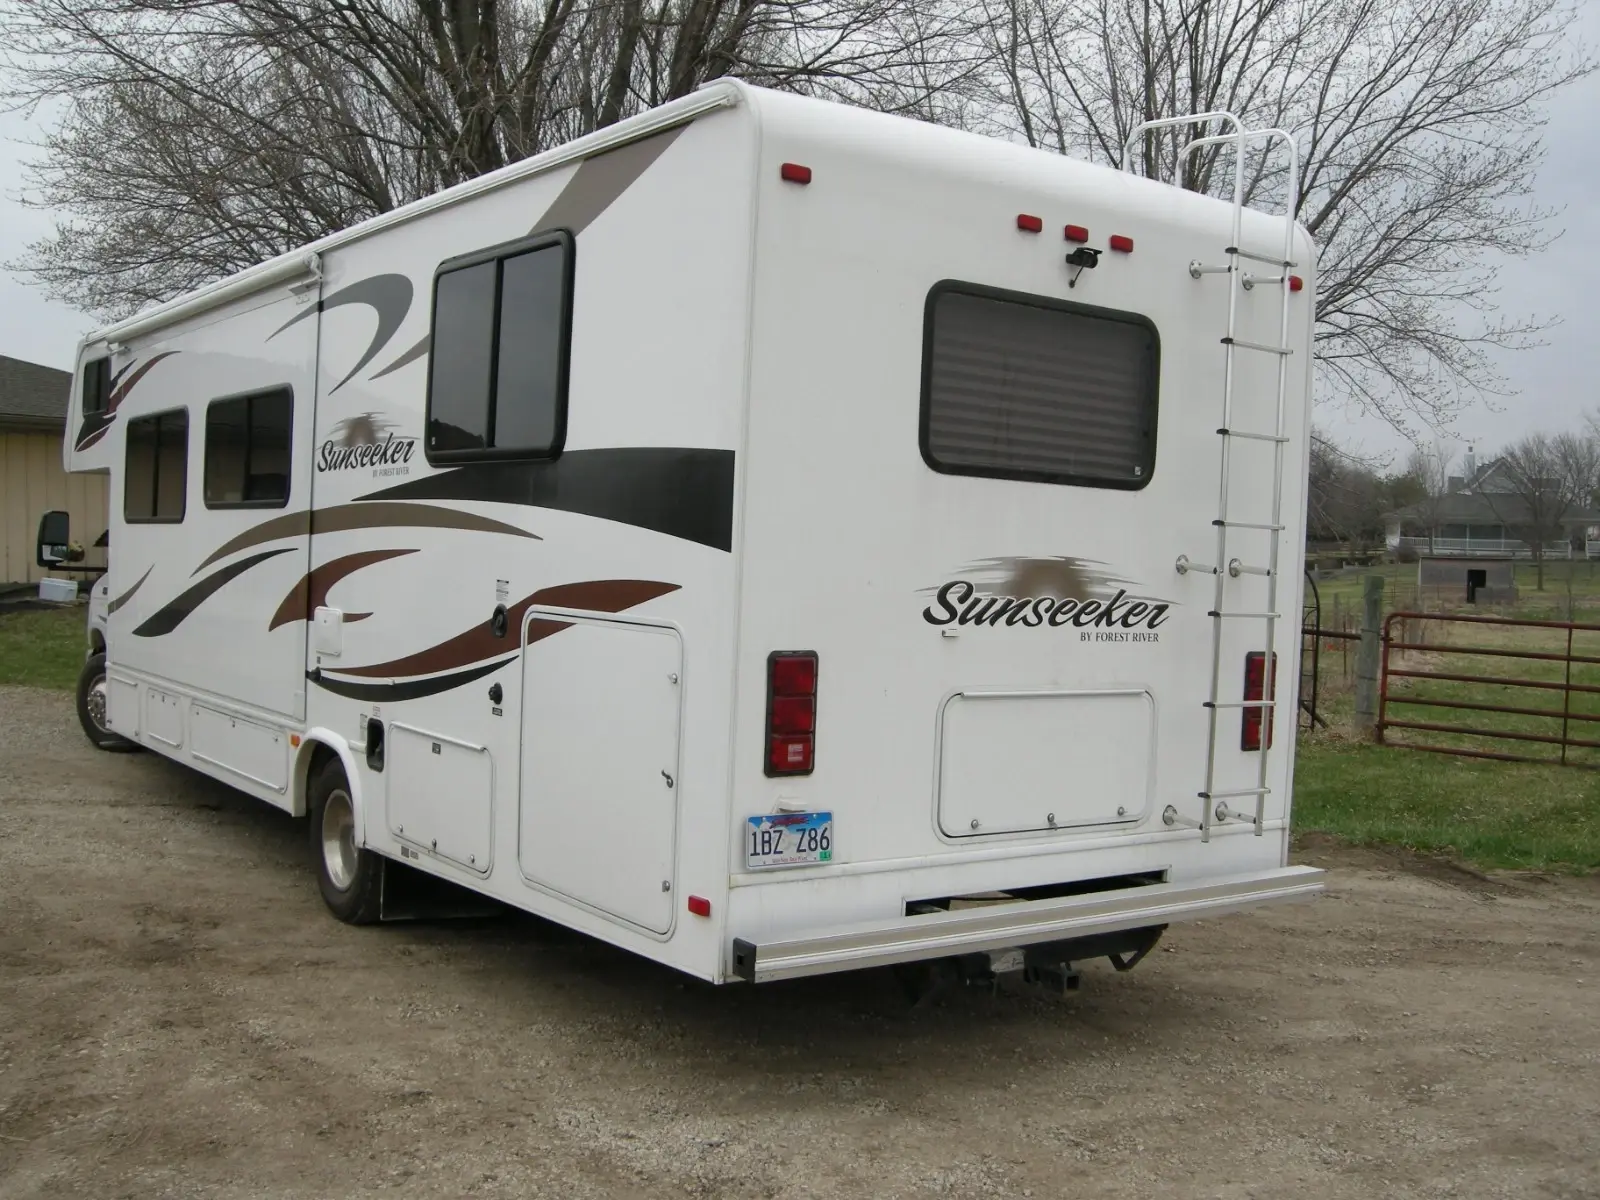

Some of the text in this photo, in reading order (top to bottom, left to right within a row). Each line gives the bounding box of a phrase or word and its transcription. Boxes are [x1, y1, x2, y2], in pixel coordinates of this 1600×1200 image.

[317, 432, 415, 472] Sunseeker
[922, 580, 1170, 630] Sunseeker
[1080, 631, 1160, 643] BY FOREST RIVER
[749, 827, 830, 857] 1BZ Z86
